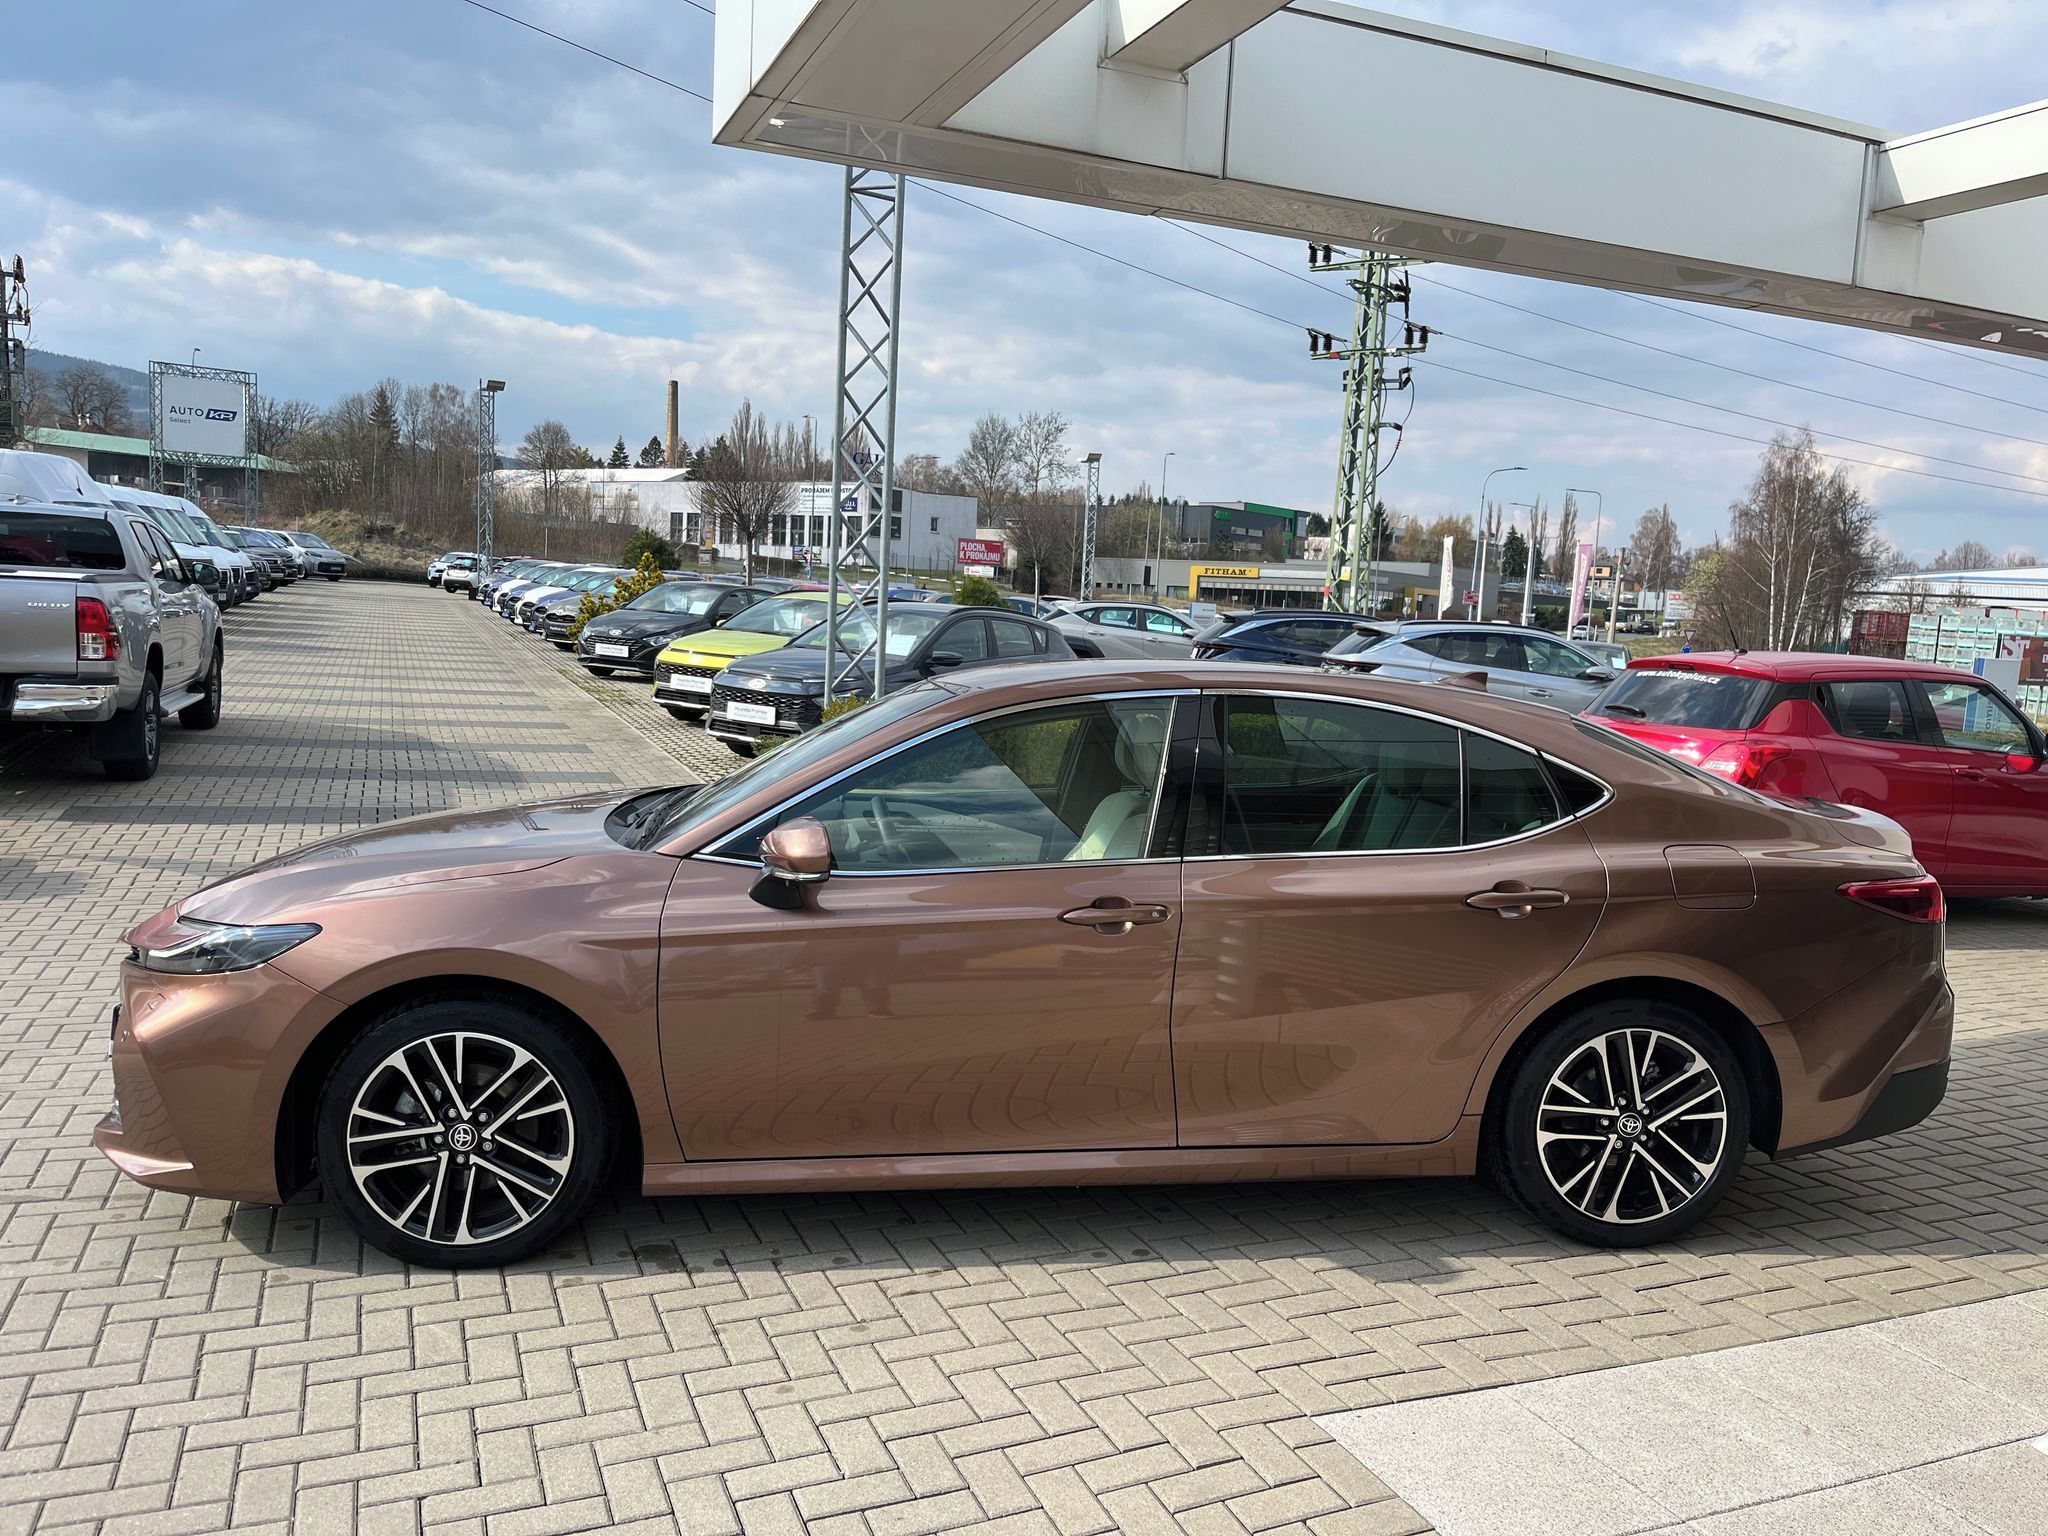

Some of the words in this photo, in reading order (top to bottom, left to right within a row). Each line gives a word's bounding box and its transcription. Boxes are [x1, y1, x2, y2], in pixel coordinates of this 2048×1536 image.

[169, 406, 204, 417] AUTO
[960, 542, 986, 552] PLOCHA
[966, 551, 1000, 561] PRONÁJMU
[1204, 568, 1247, 576] FITHAM
[1636, 670, 1720, 685] www.autokpplus.cz
